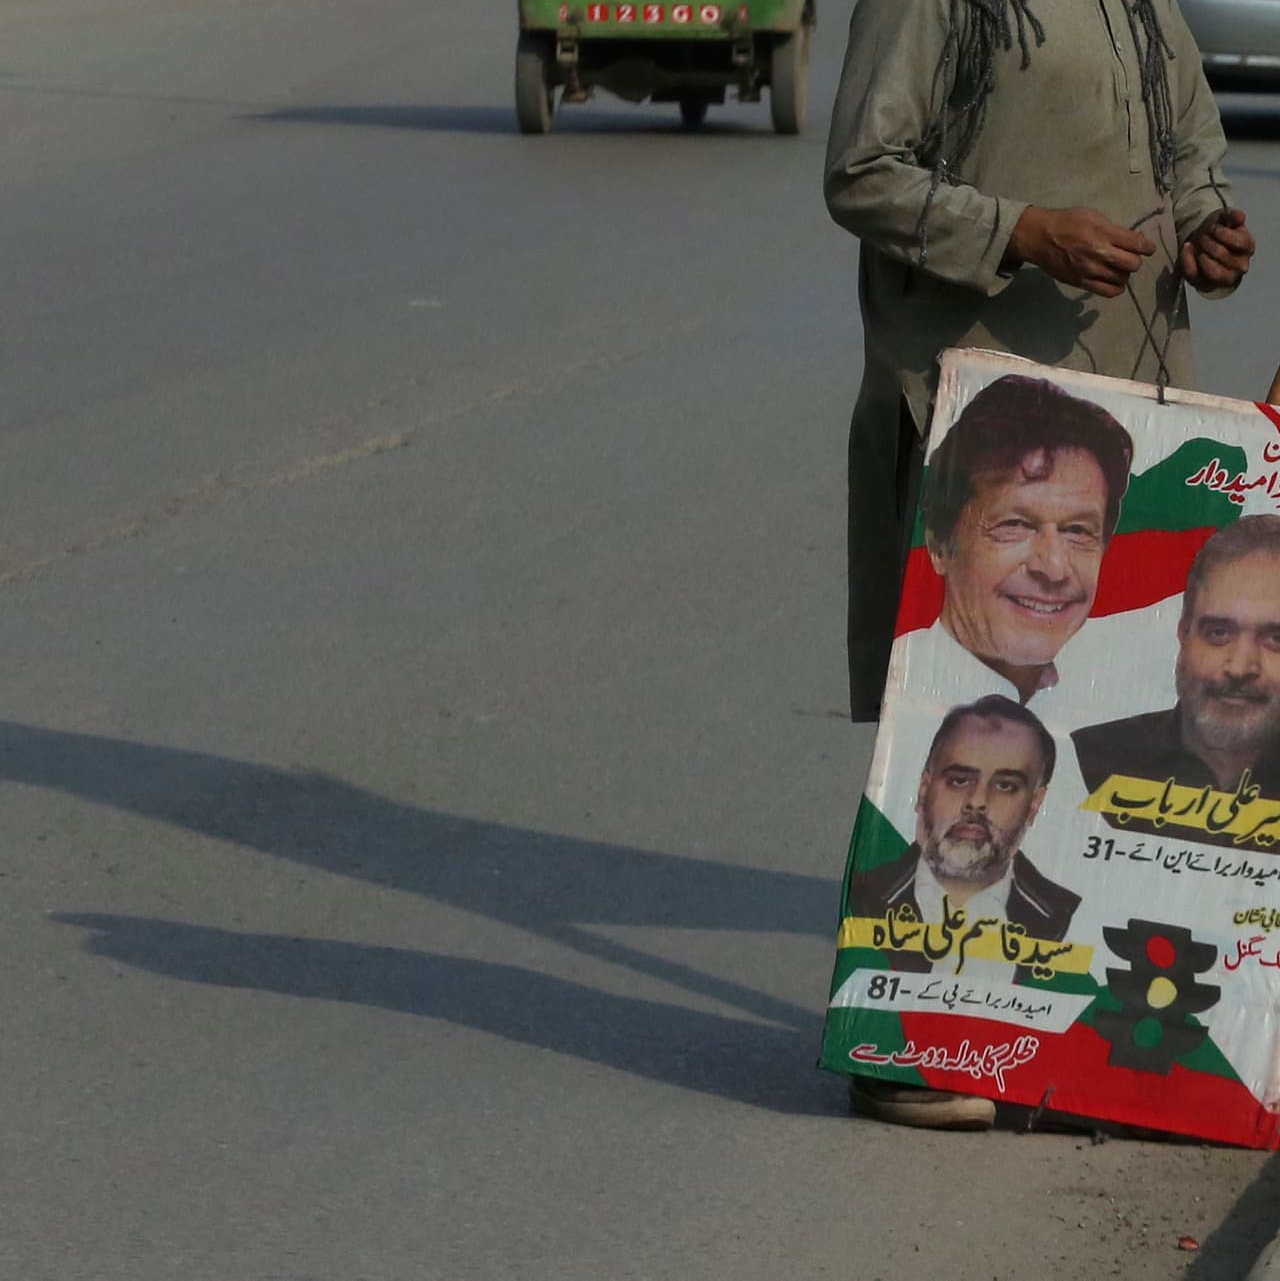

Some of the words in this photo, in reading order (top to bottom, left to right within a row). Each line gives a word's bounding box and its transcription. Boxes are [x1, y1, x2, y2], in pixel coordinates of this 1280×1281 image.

[1186, 459, 1279, 504] امیدوار
[1110, 777, 1211, 827] ارباب
[1205, 768, 1260, 833] علی
[873, 905, 922, 950] شاہ
[923, 895, 965, 960] علی
[1233, 907, 1265, 928] نشان
[956, 917, 1026, 975] قاسم
[1022, 943, 1073, 979] سید
[1224, 935, 1267, 970] سگنل
[917, 981, 943, 1000] کے
[1005, 997, 1052, 1019] امیدوار
[850, 1043, 890, 1065] سے
